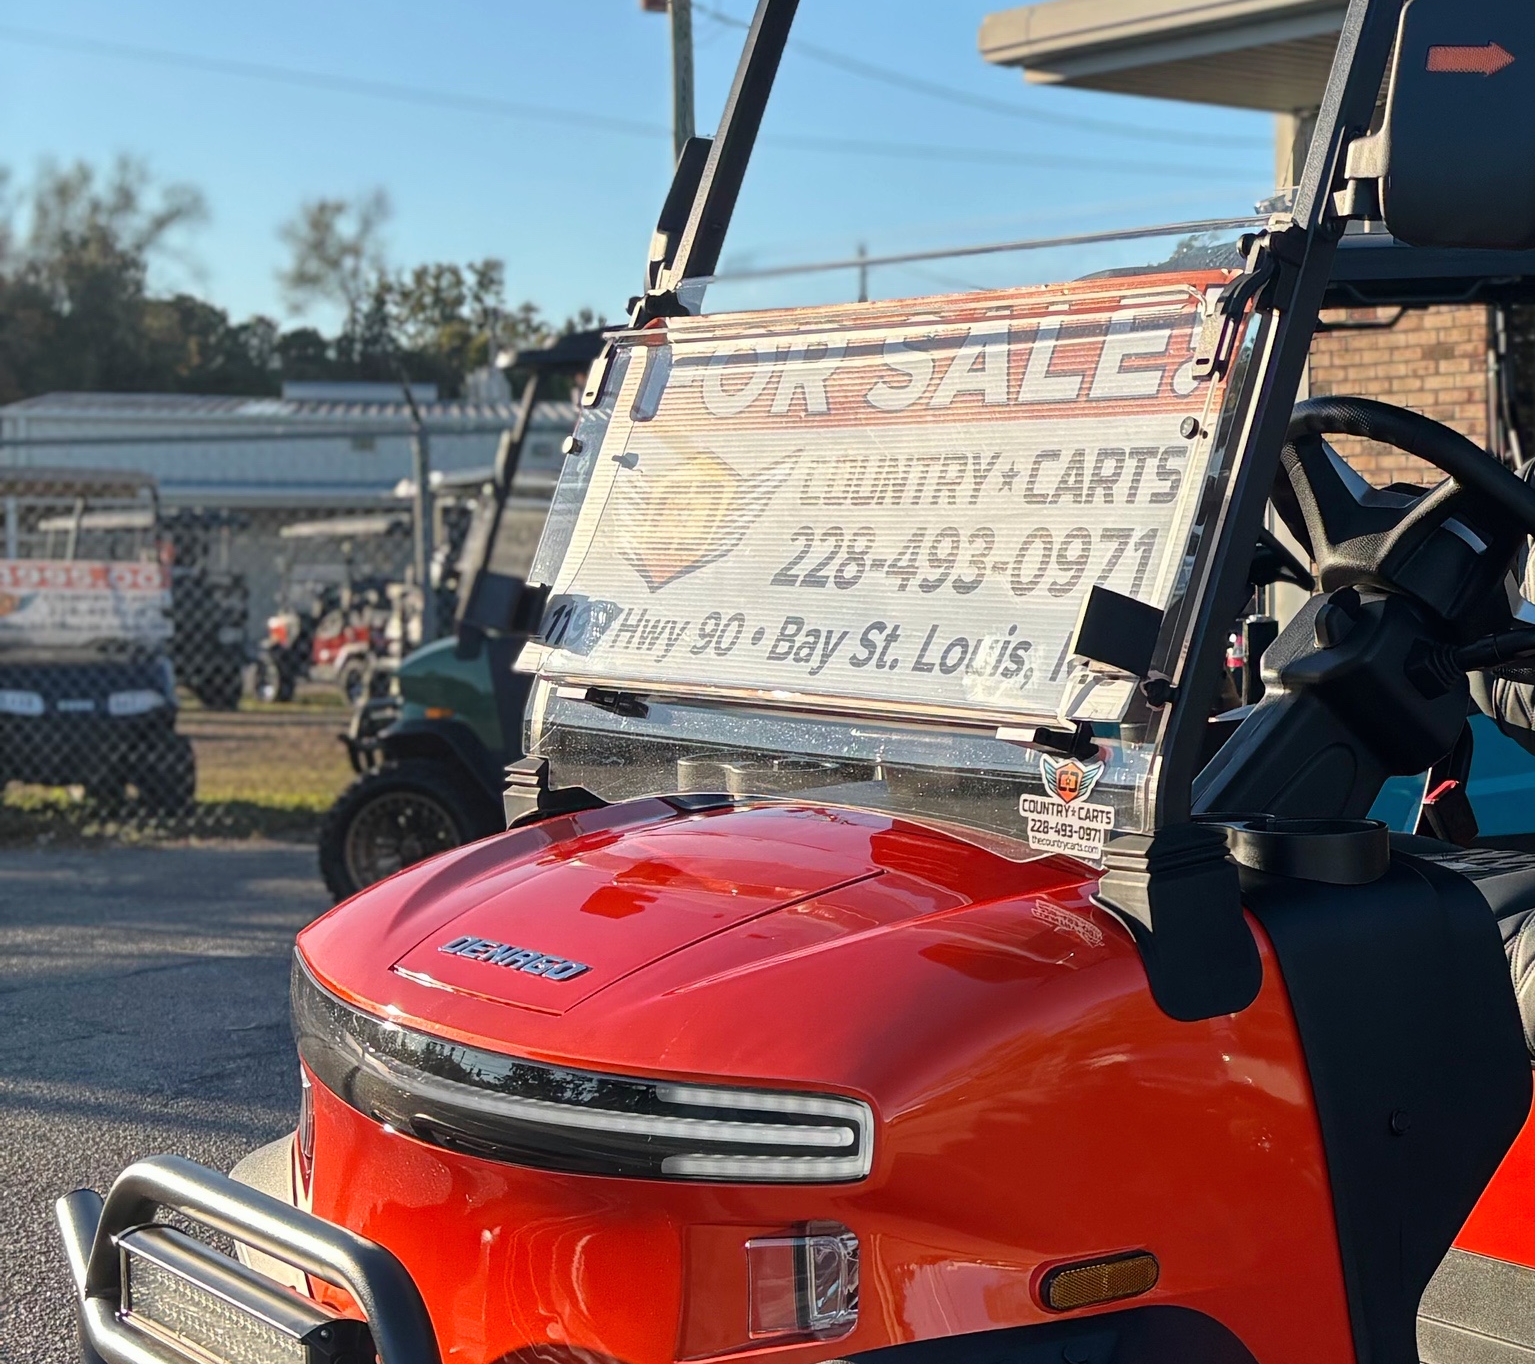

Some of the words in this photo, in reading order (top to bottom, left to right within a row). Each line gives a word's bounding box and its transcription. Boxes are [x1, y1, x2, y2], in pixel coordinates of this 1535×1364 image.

[799, 452, 1000, 507] COUNTRY
[1022, 446, 1189, 506] CARTS
[770, 525, 1160, 598] 228-493-0971
[608, 607, 691, 664] Hwy
[690, 611, 746, 657] 90
[766, 616, 850, 676] Bay
[848, 620, 901, 671] St.
[1022, 798, 1071, 819] COUNTRY
[1077, 806, 1112, 825] CARTS
[1030, 818, 1101, 844] 228-493-0971
[1031, 834, 1099, 854] thecountrycarts.com
[438, 935, 594, 982] DENAGO
